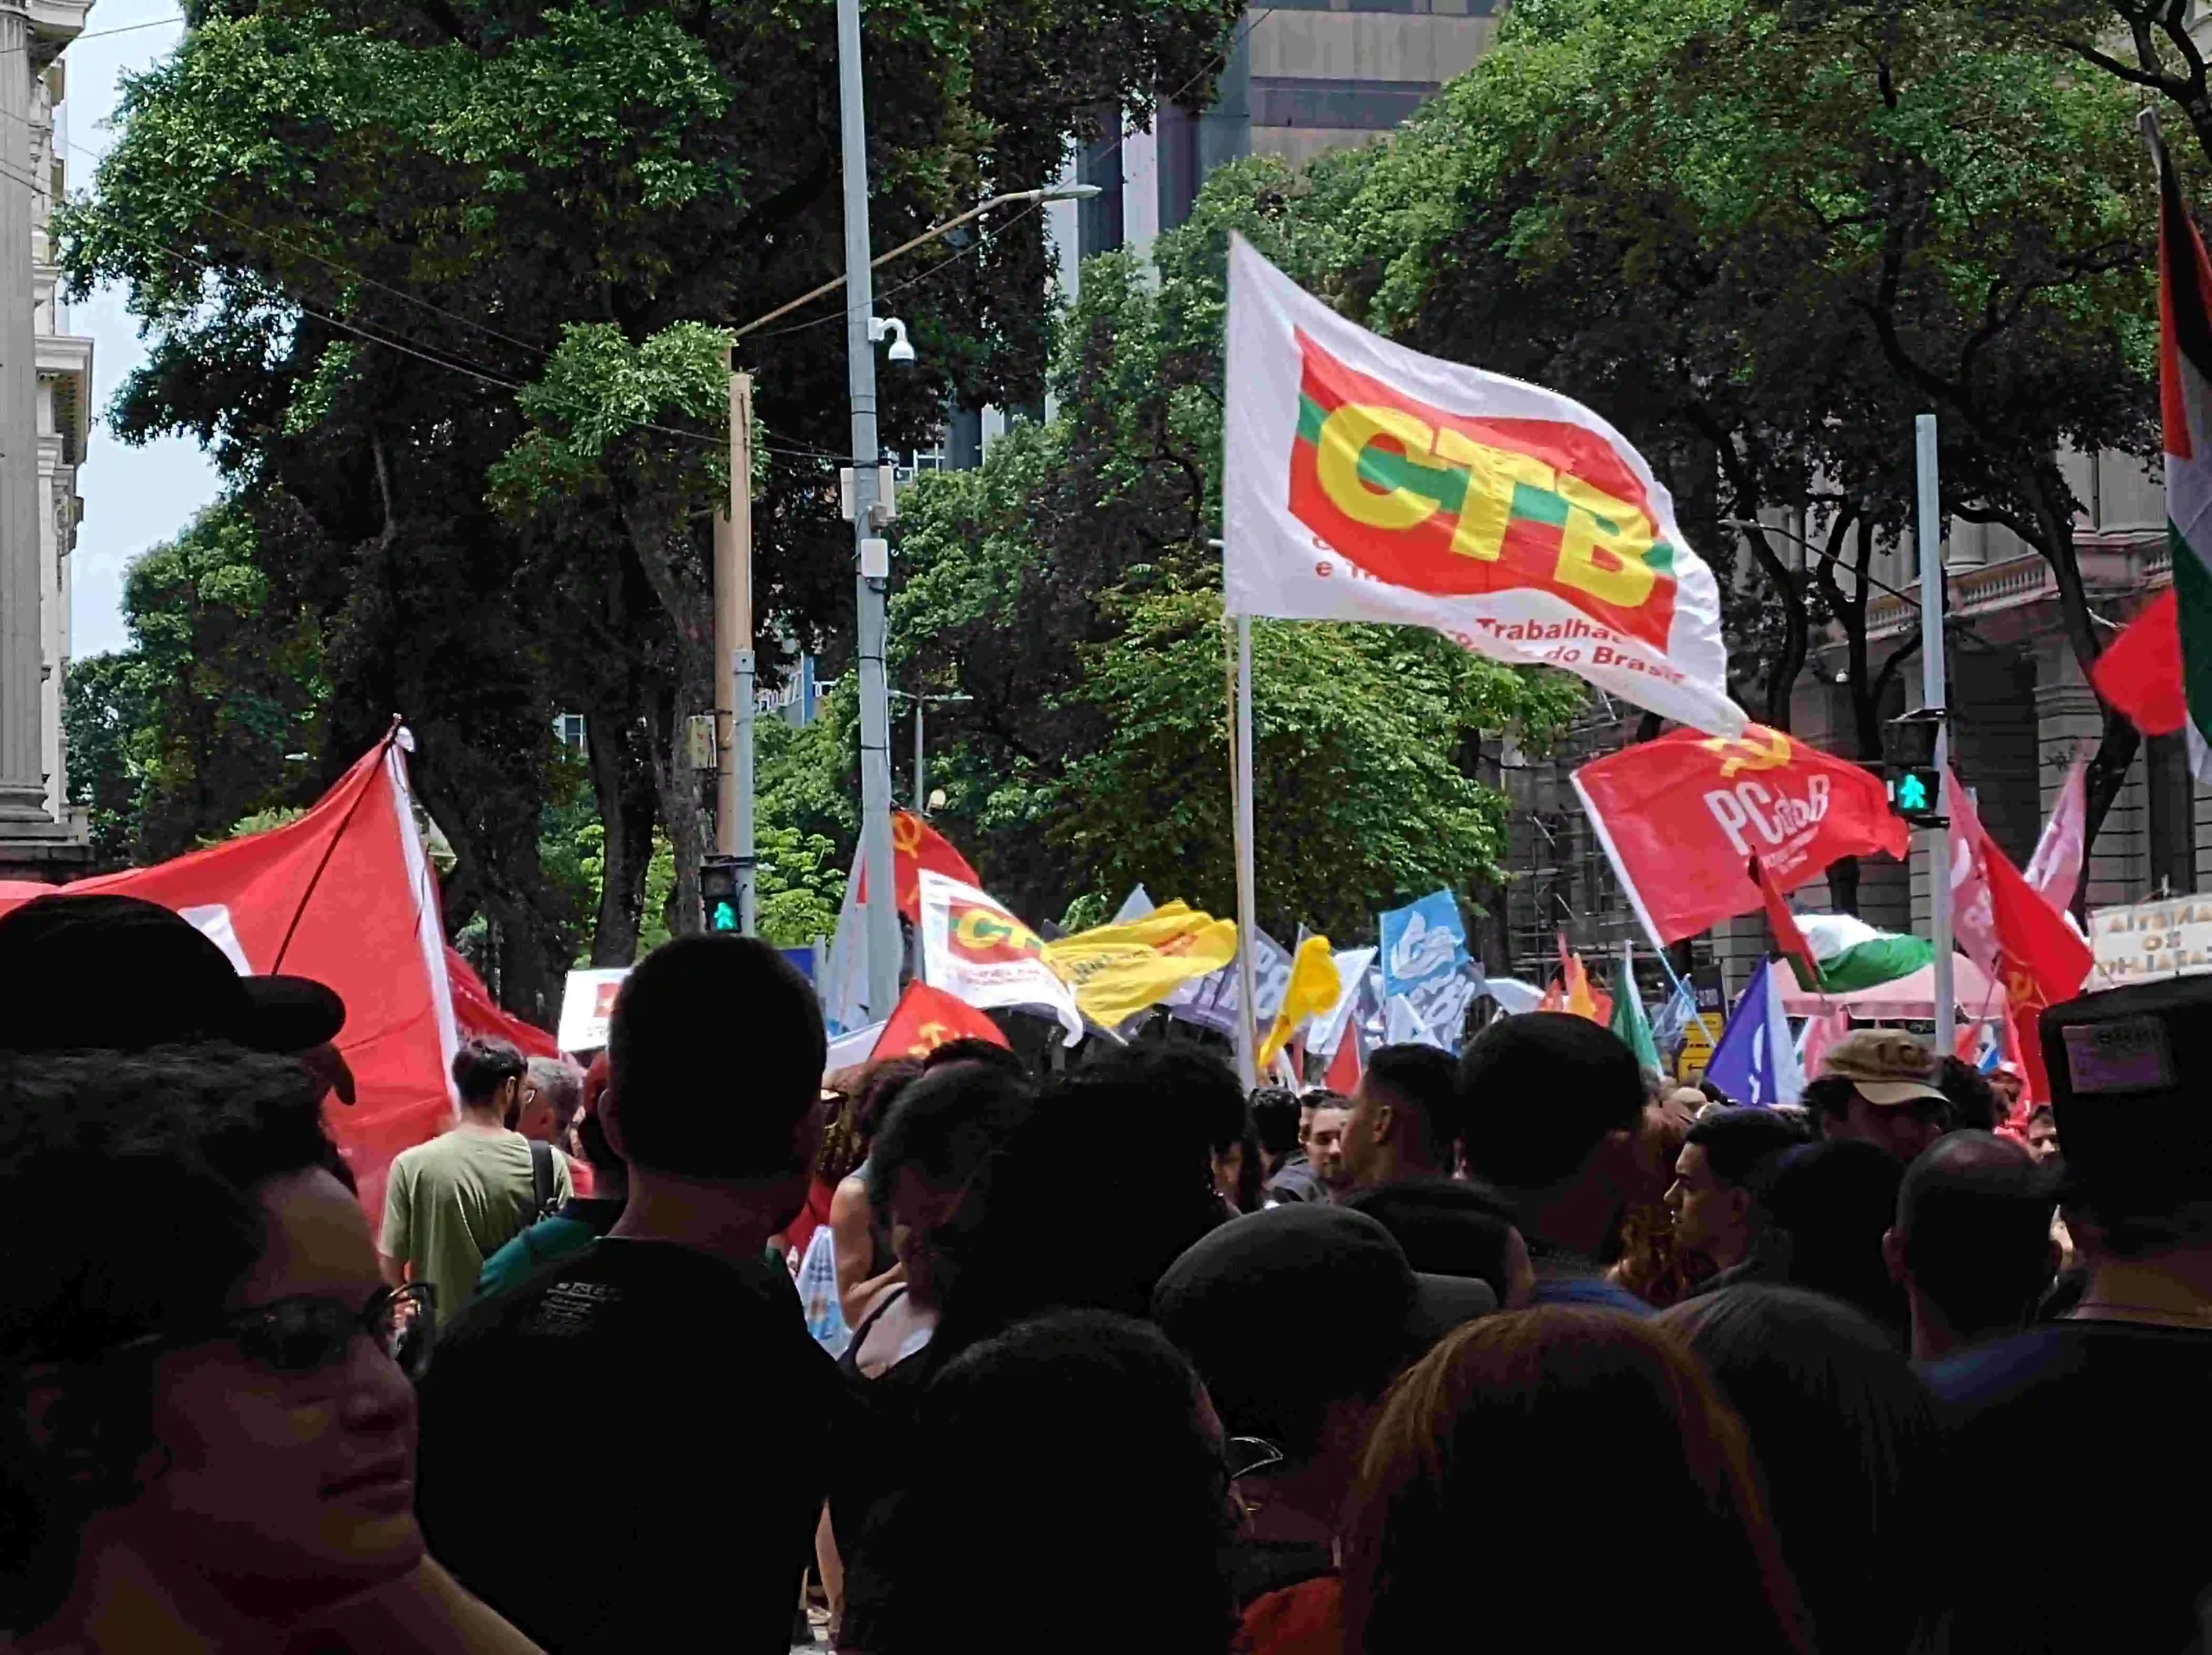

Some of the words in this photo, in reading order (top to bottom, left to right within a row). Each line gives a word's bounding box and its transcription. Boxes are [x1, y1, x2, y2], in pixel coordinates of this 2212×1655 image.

[1317, 405, 1657, 608] CTB
[1544, 646, 1581, 663] do
[1703, 774, 1830, 856] PCdoB
